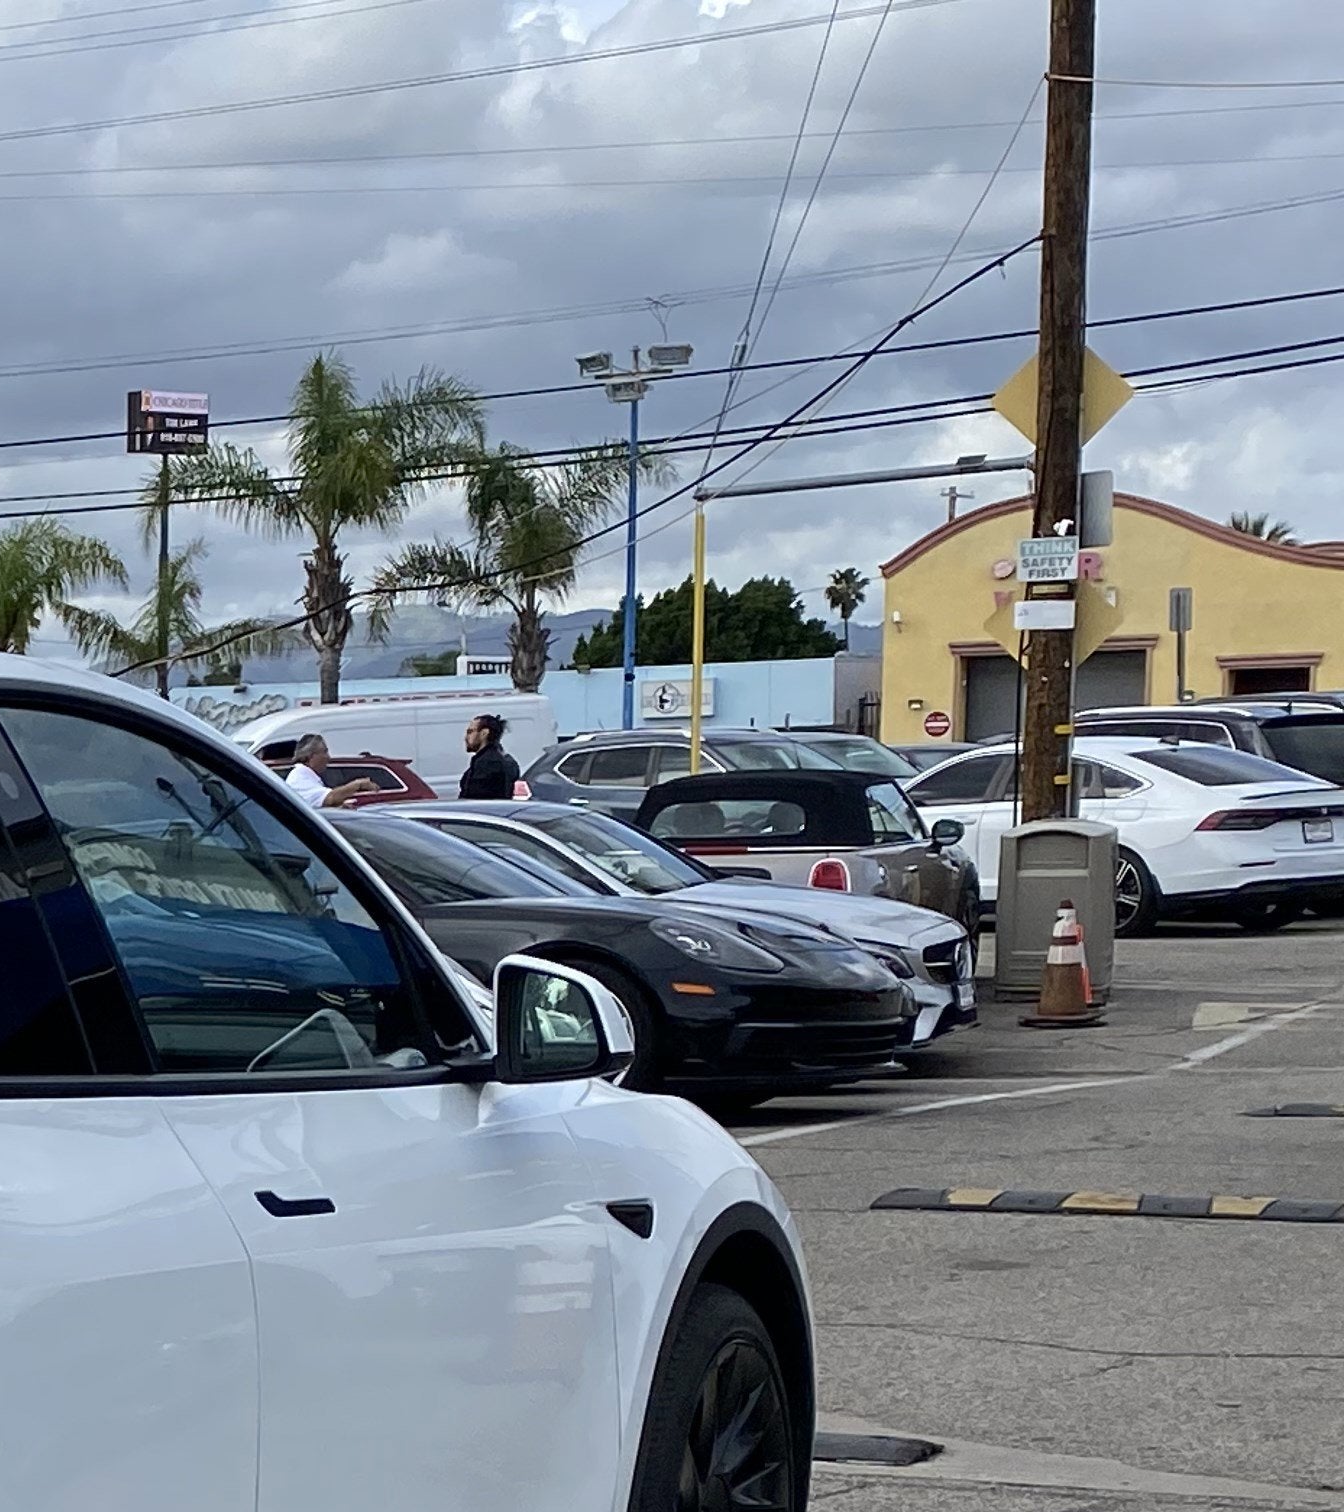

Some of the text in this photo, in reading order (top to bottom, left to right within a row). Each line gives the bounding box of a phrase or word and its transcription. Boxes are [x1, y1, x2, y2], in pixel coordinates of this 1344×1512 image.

[1022, 540, 1075, 555] THINK
[1022, 556, 1074, 568] SAFETY
[1028, 566, 1068, 578] FIRST
